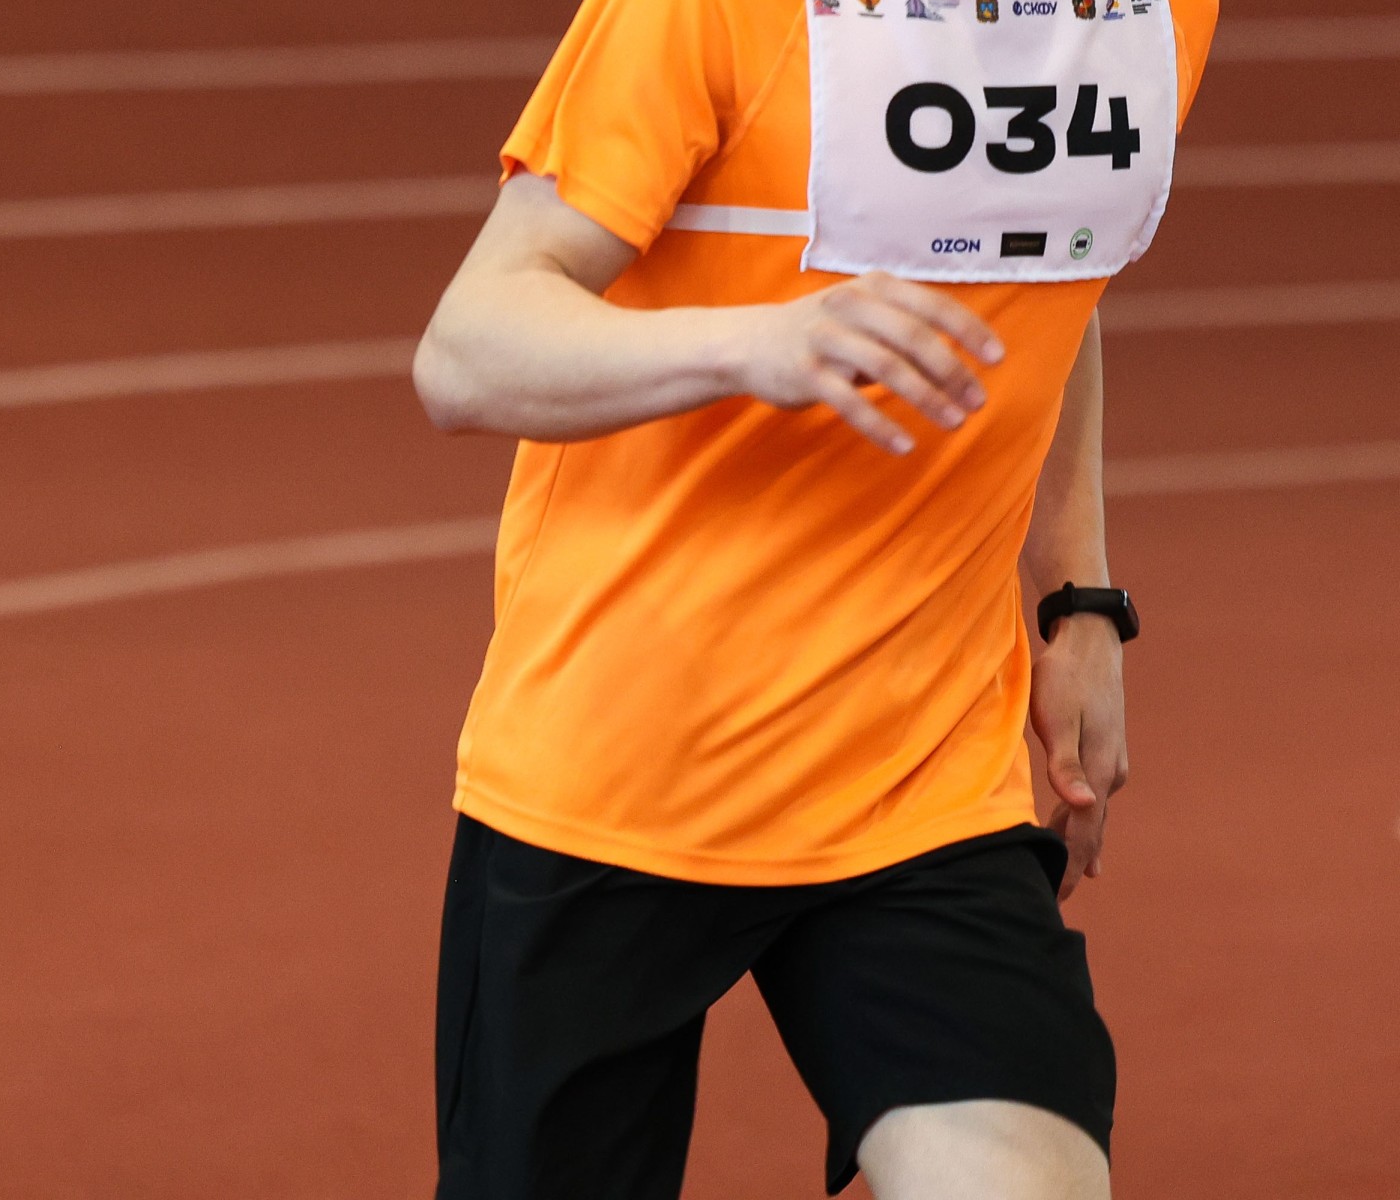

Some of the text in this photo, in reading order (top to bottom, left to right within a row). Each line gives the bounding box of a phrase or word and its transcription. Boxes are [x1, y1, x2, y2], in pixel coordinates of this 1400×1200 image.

[1023, 0, 1058, 16] СКФУ
[885, 82, 1141, 175] 034
[931, 238, 981, 253] OZON
